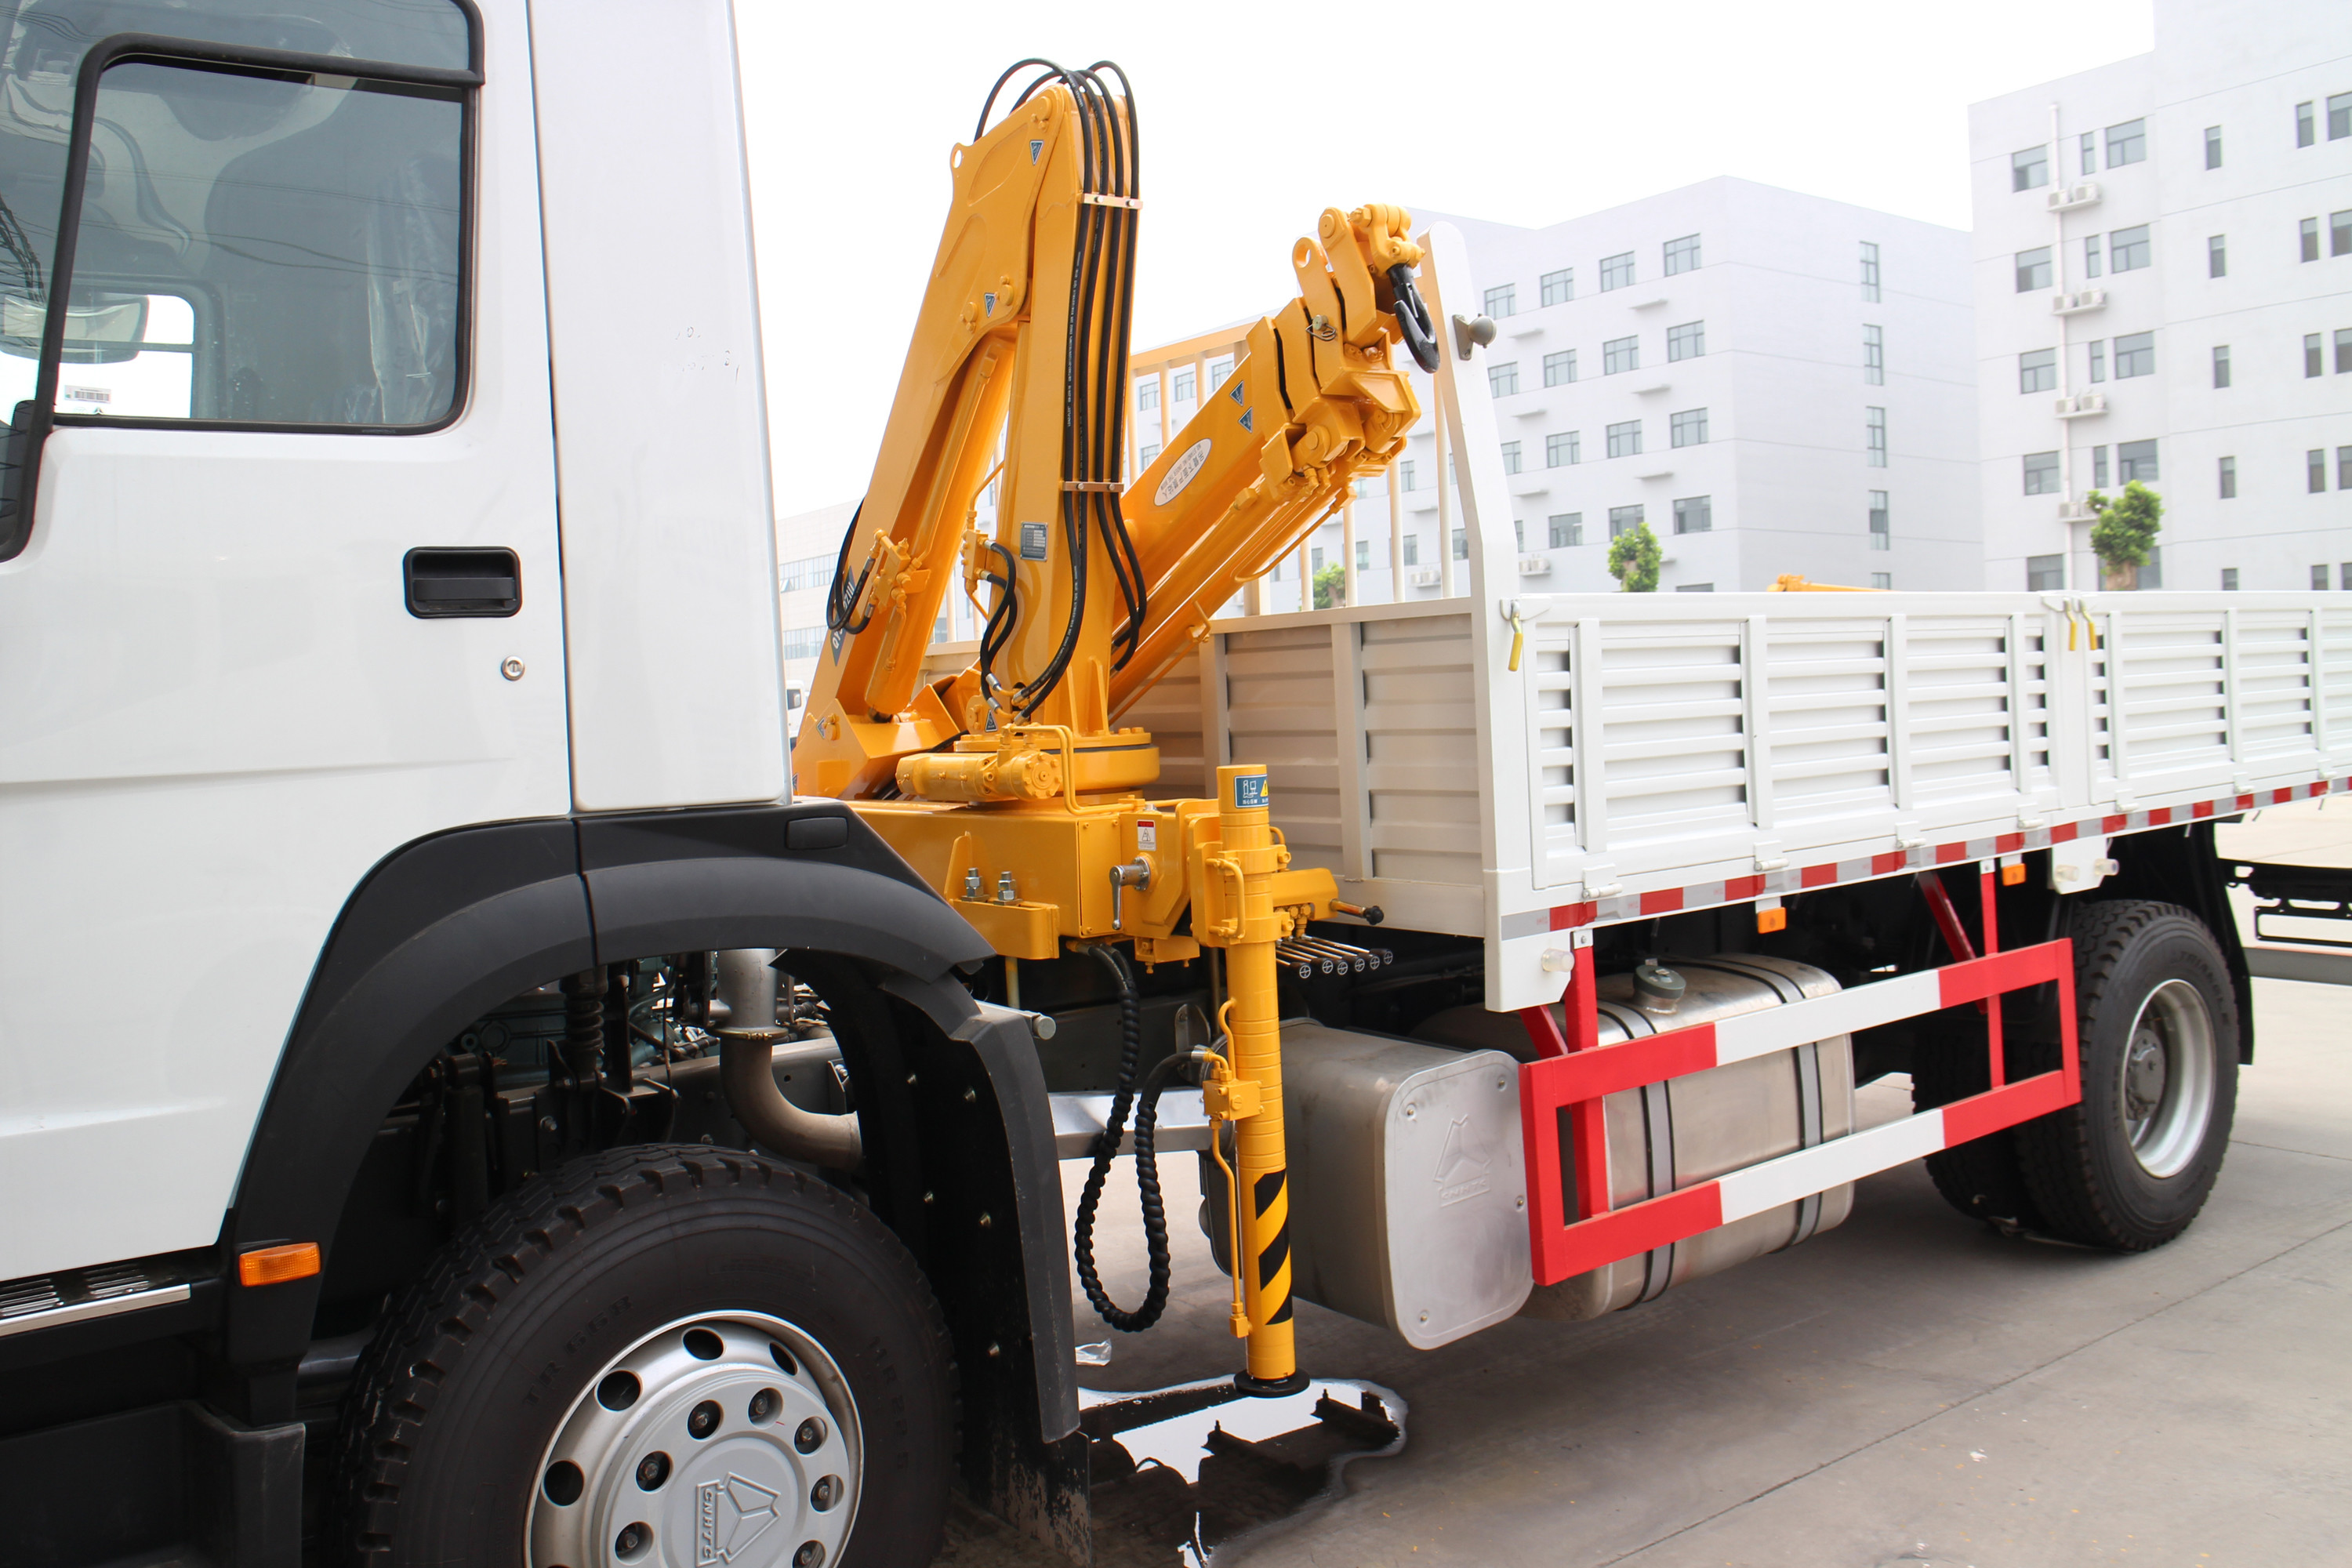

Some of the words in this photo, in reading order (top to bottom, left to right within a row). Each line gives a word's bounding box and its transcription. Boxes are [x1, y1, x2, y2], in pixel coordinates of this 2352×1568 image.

[1442, 1179, 1487, 1200] CNHTC
[522, 1360, 565, 1406] TR
[564, 1294, 633, 1356] 668
[702, 1487, 713, 1559] CNHTC
